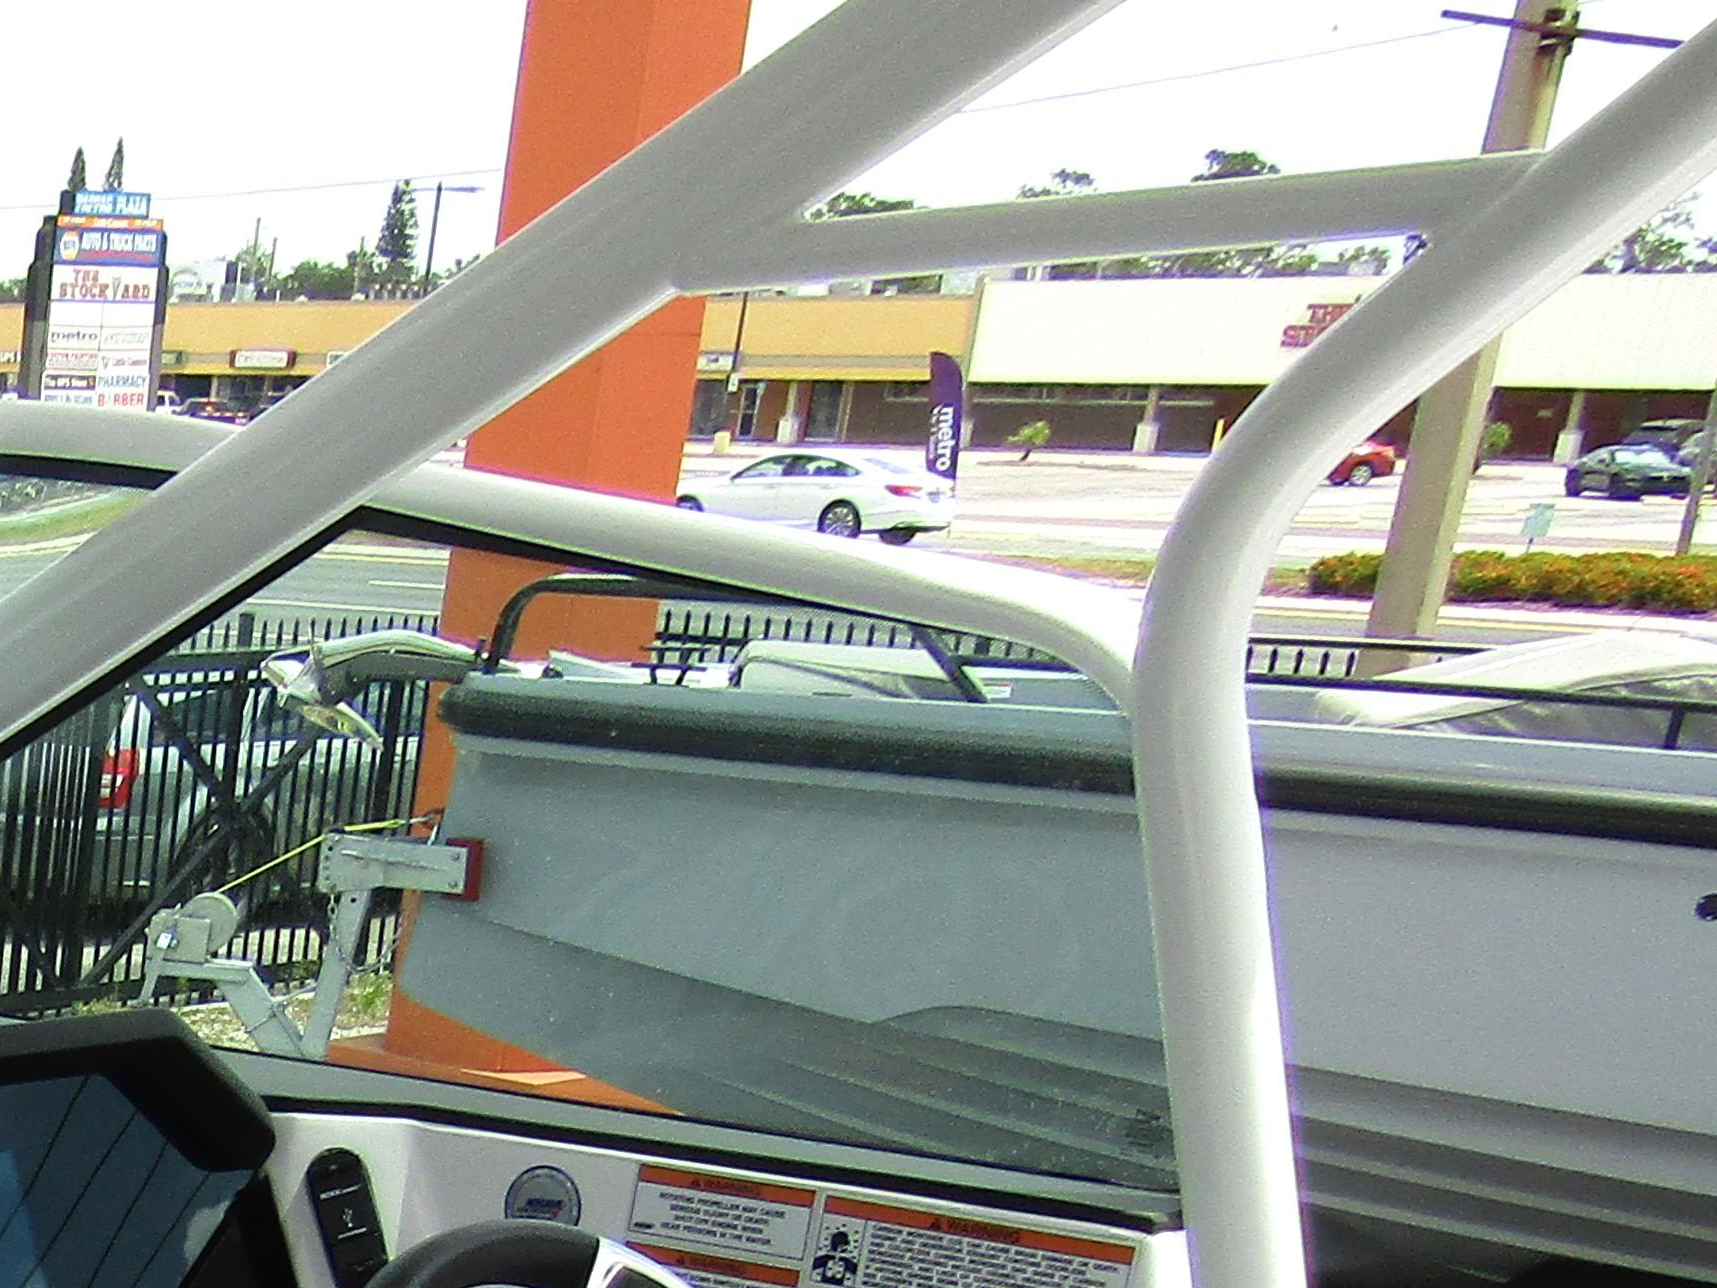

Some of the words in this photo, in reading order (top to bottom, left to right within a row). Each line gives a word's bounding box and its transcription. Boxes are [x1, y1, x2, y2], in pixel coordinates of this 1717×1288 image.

[51, 329, 98, 344] metro
[98, 375, 146, 389] PHARMACY
[935, 406, 956, 471] metro
[947, 1220, 1022, 1243] WARNING
